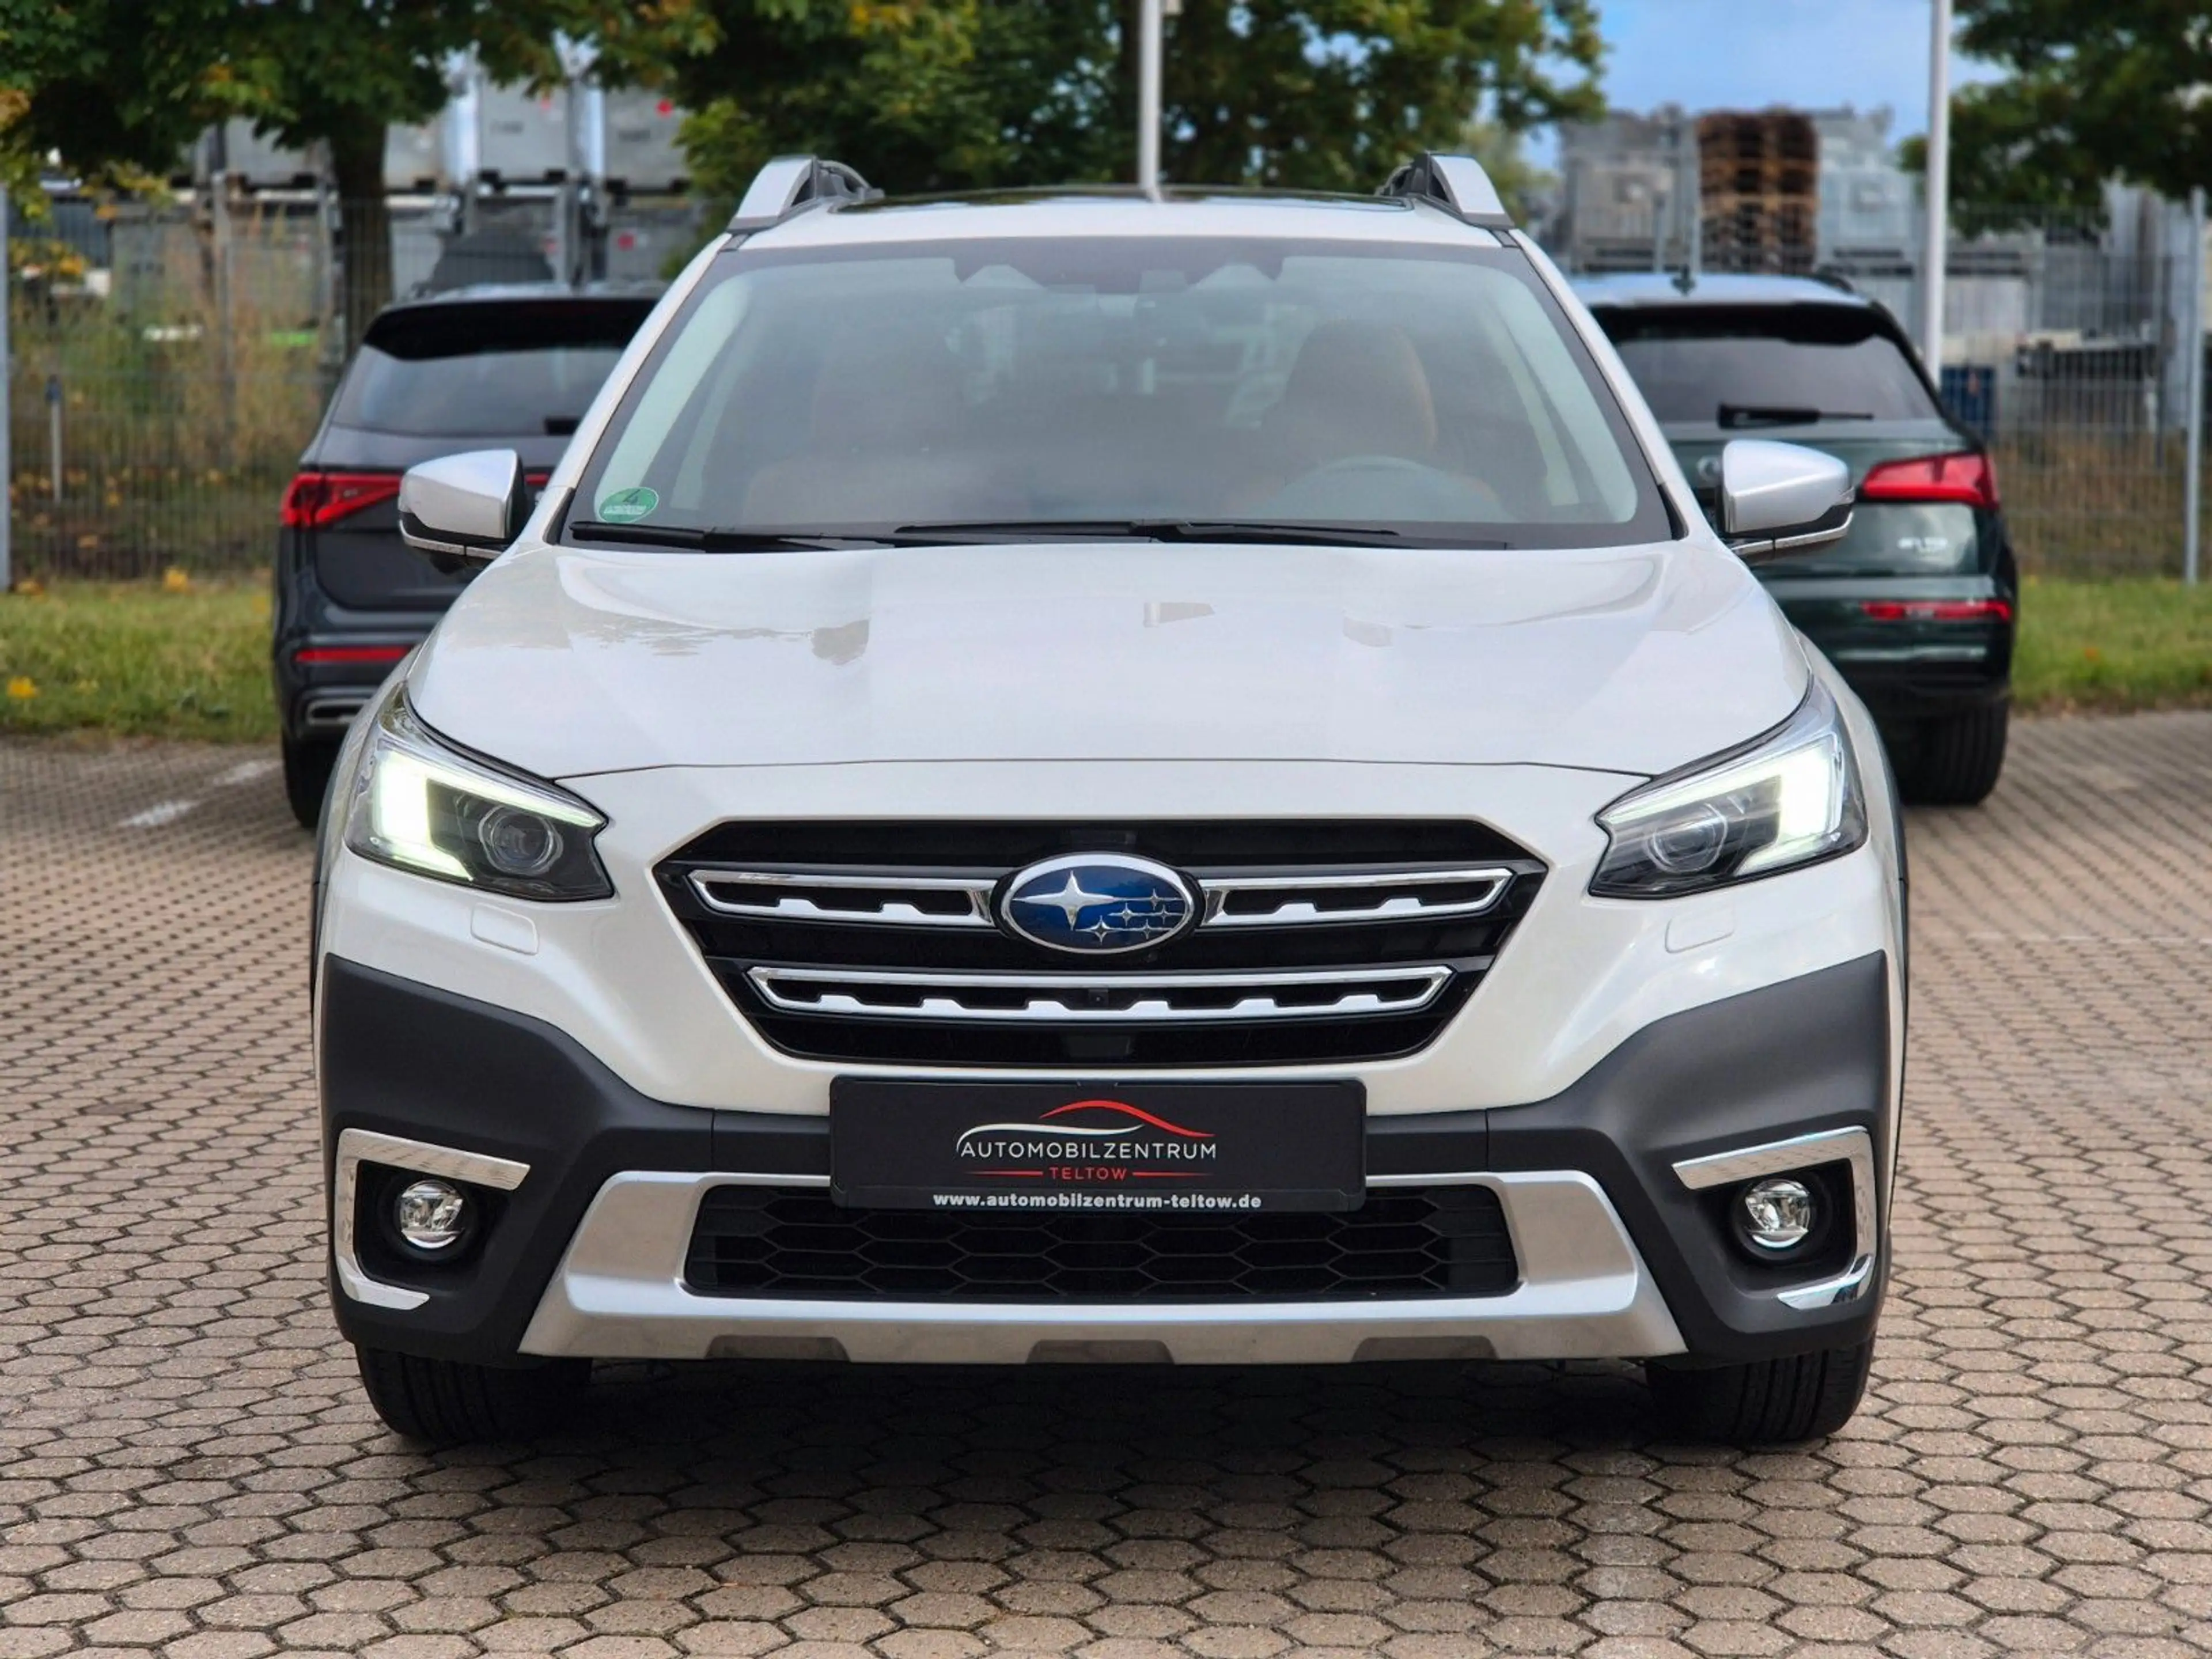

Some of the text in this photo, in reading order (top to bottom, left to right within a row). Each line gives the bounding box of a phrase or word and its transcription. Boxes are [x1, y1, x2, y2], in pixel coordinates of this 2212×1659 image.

[960, 1141, 1217, 1160] AUTOMOBILZENTRUM
[1050, 1166, 1127, 1181] TELTOW
[933, 1193, 1262, 1208] www.automobilzentrum-teltow.de
